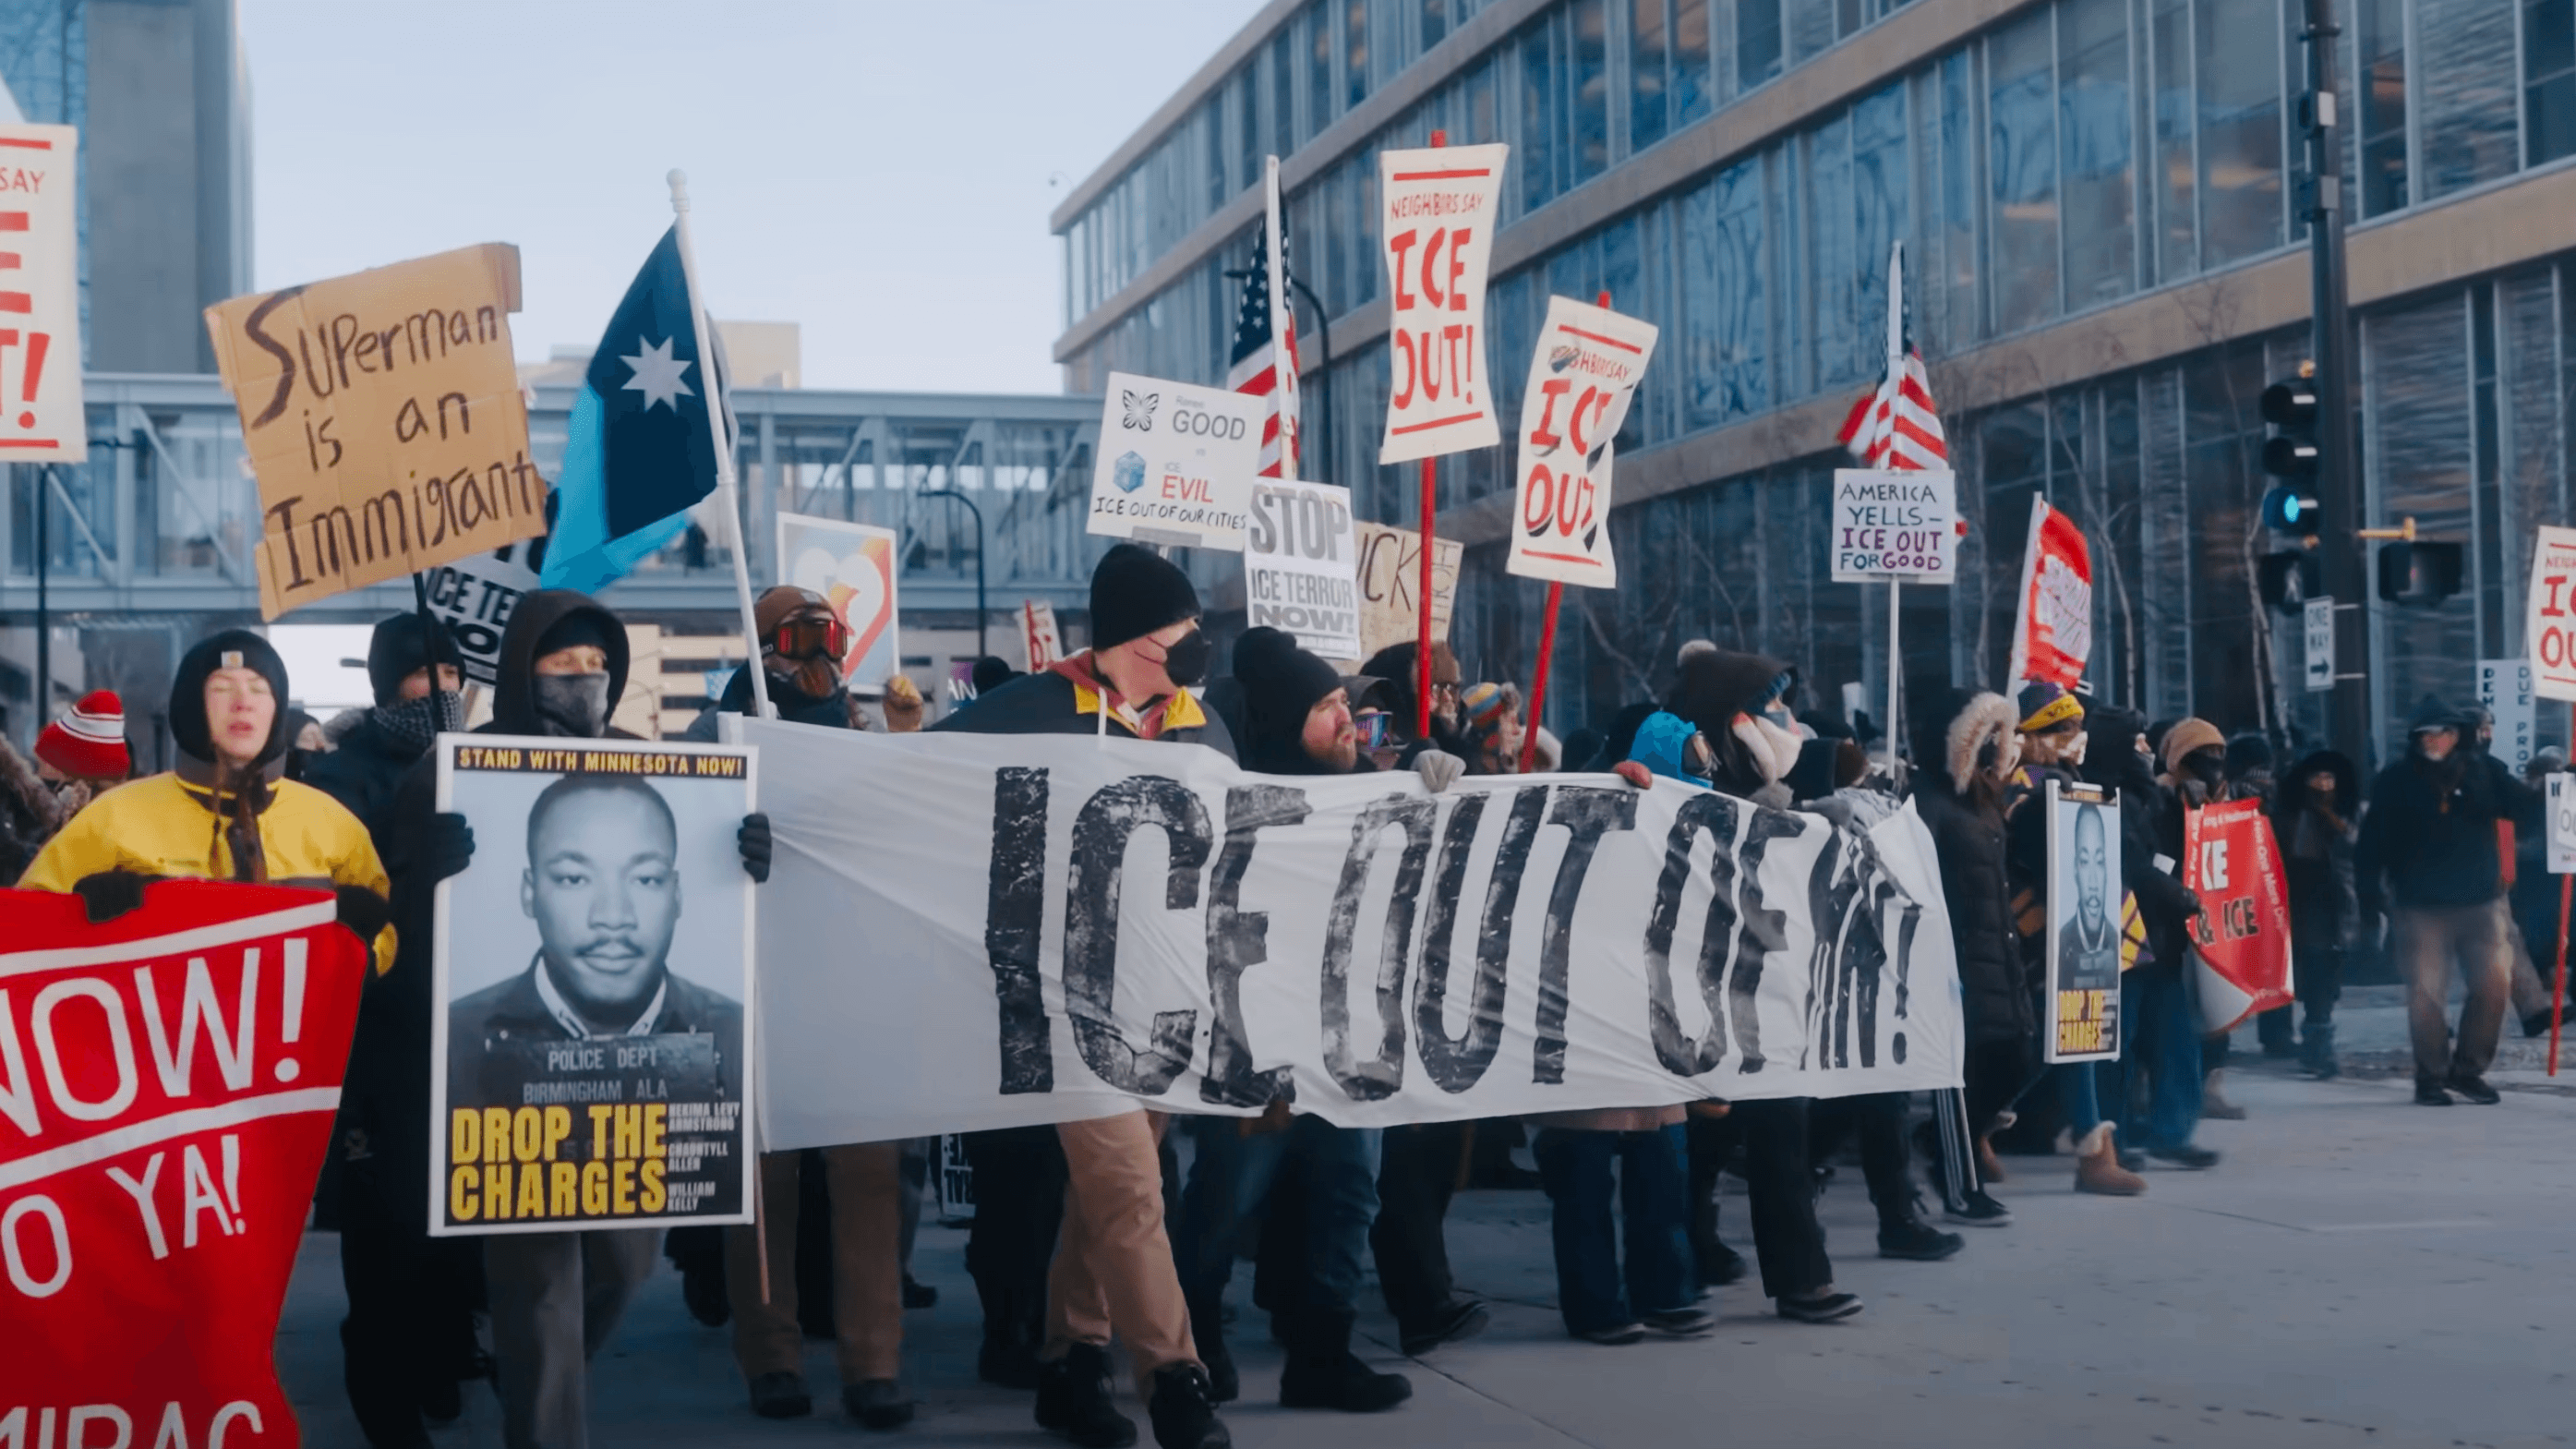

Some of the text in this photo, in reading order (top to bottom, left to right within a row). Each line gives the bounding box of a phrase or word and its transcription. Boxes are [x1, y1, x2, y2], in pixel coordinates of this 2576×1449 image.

[1462, 192, 1485, 213] SAY
[1390, 226, 1472, 312] ICE
[1392, 323, 1474, 410] OUT!
[303, 392, 471, 472] is an
[1173, 409, 1246, 441] GOOD
[1162, 474, 1214, 503] EVIL
[1839, 483, 1937, 503] AMERICA
[264, 450, 536, 592] Immigrant
[1094, 496, 1246, 530] ICE OUT OF OUR CITIES
[1249, 485, 1349, 561] STOP
[1840, 526, 1943, 552] ICE OUT
[1840, 551, 1943, 571] FOR GOOD
[1251, 567, 1354, 610] ICE TERROR
[1253, 603, 1354, 634] NOW!
[459, 747, 743, 777] STAND WITH MINNESOTA NOW!
[987, 766, 1313, 1107] ICE
[1320, 784, 1640, 1102] OUT
[1643, 791, 1807, 1078] OF
[2222, 896, 2260, 941] ICE
[548, 1046, 658, 1072] POLICE DEPT
[523, 1078, 668, 1104] BIRMINGHAM ALA
[451, 1103, 668, 1165] DROP THE
[105, 1134, 247, 1260] YA!
[451, 1158, 668, 1221] CHARGES
